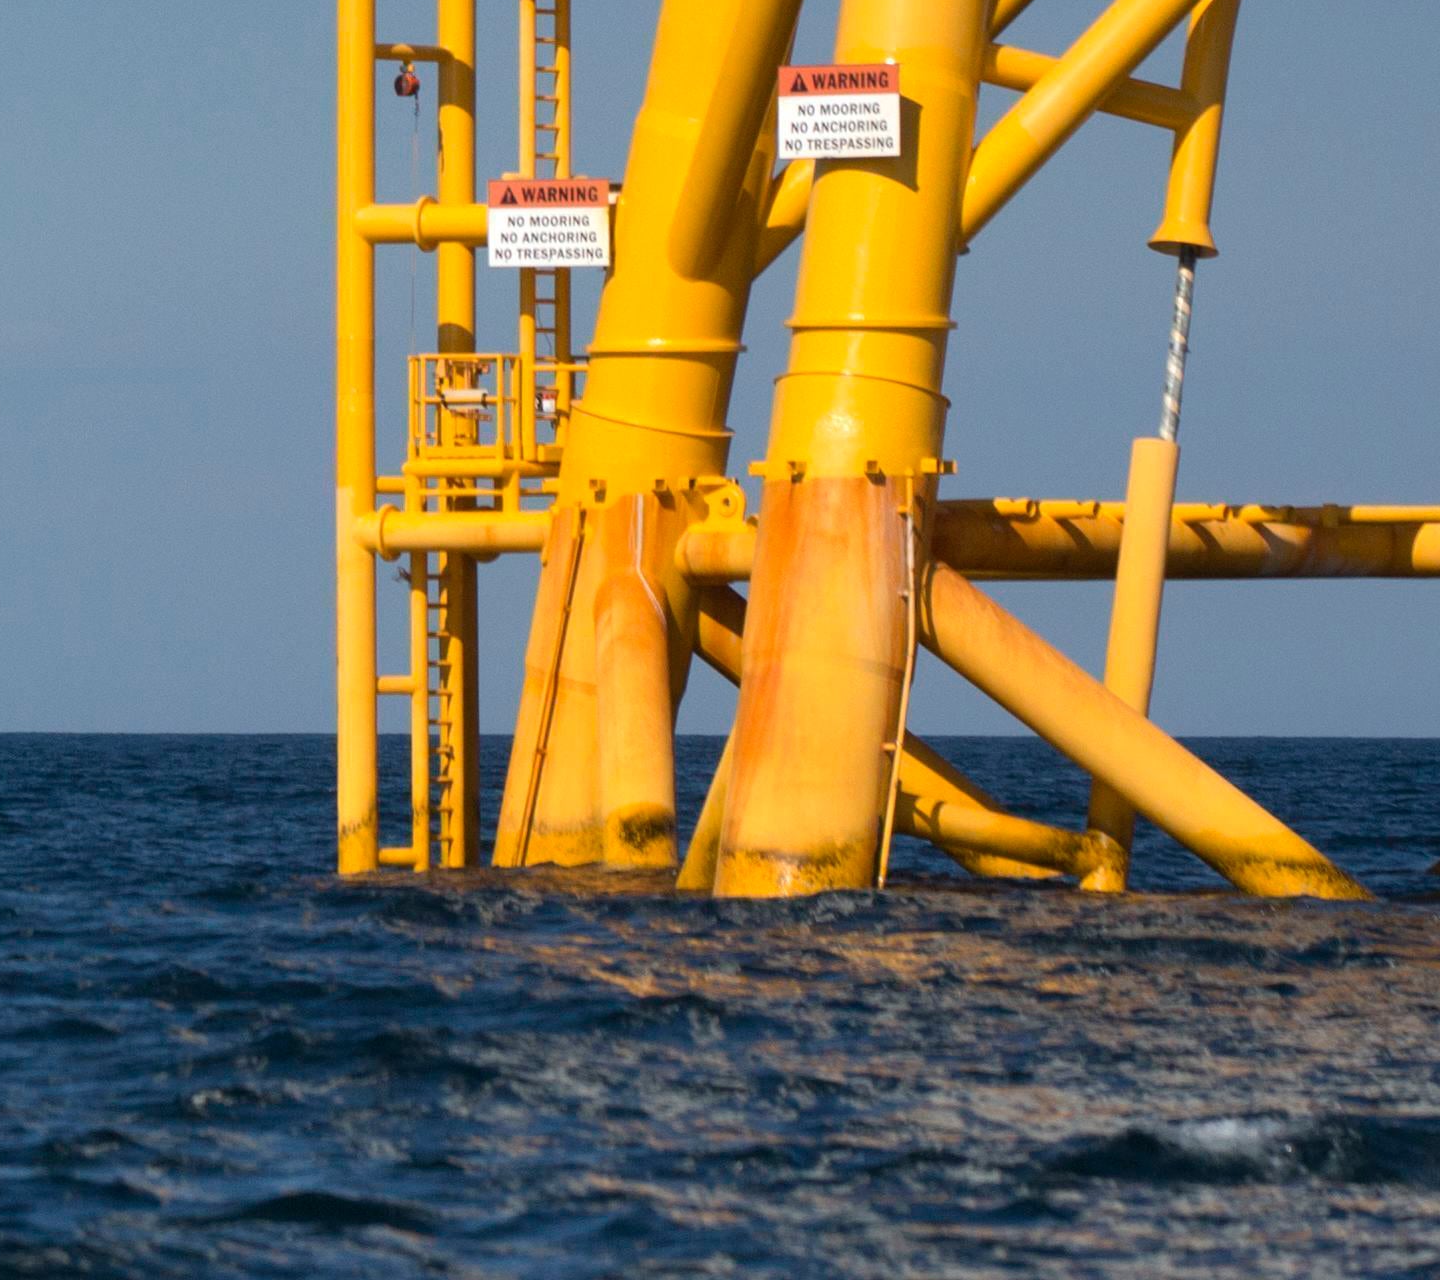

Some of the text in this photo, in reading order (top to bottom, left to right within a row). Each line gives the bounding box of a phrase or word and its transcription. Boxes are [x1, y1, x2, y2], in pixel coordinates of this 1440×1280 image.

[812, 72, 889, 89] WARNING
[798, 103, 880, 116] NO MOORING
[791, 120, 888, 134] NO ANCHORING
[785, 137, 894, 151] NO TRESPASSING
[521, 186, 598, 202] WARNING
[507, 215, 590, 227] NO MOORING
[500, 231, 597, 243] NO ANCHORING
[495, 248, 604, 260] NO TRESPASSING
